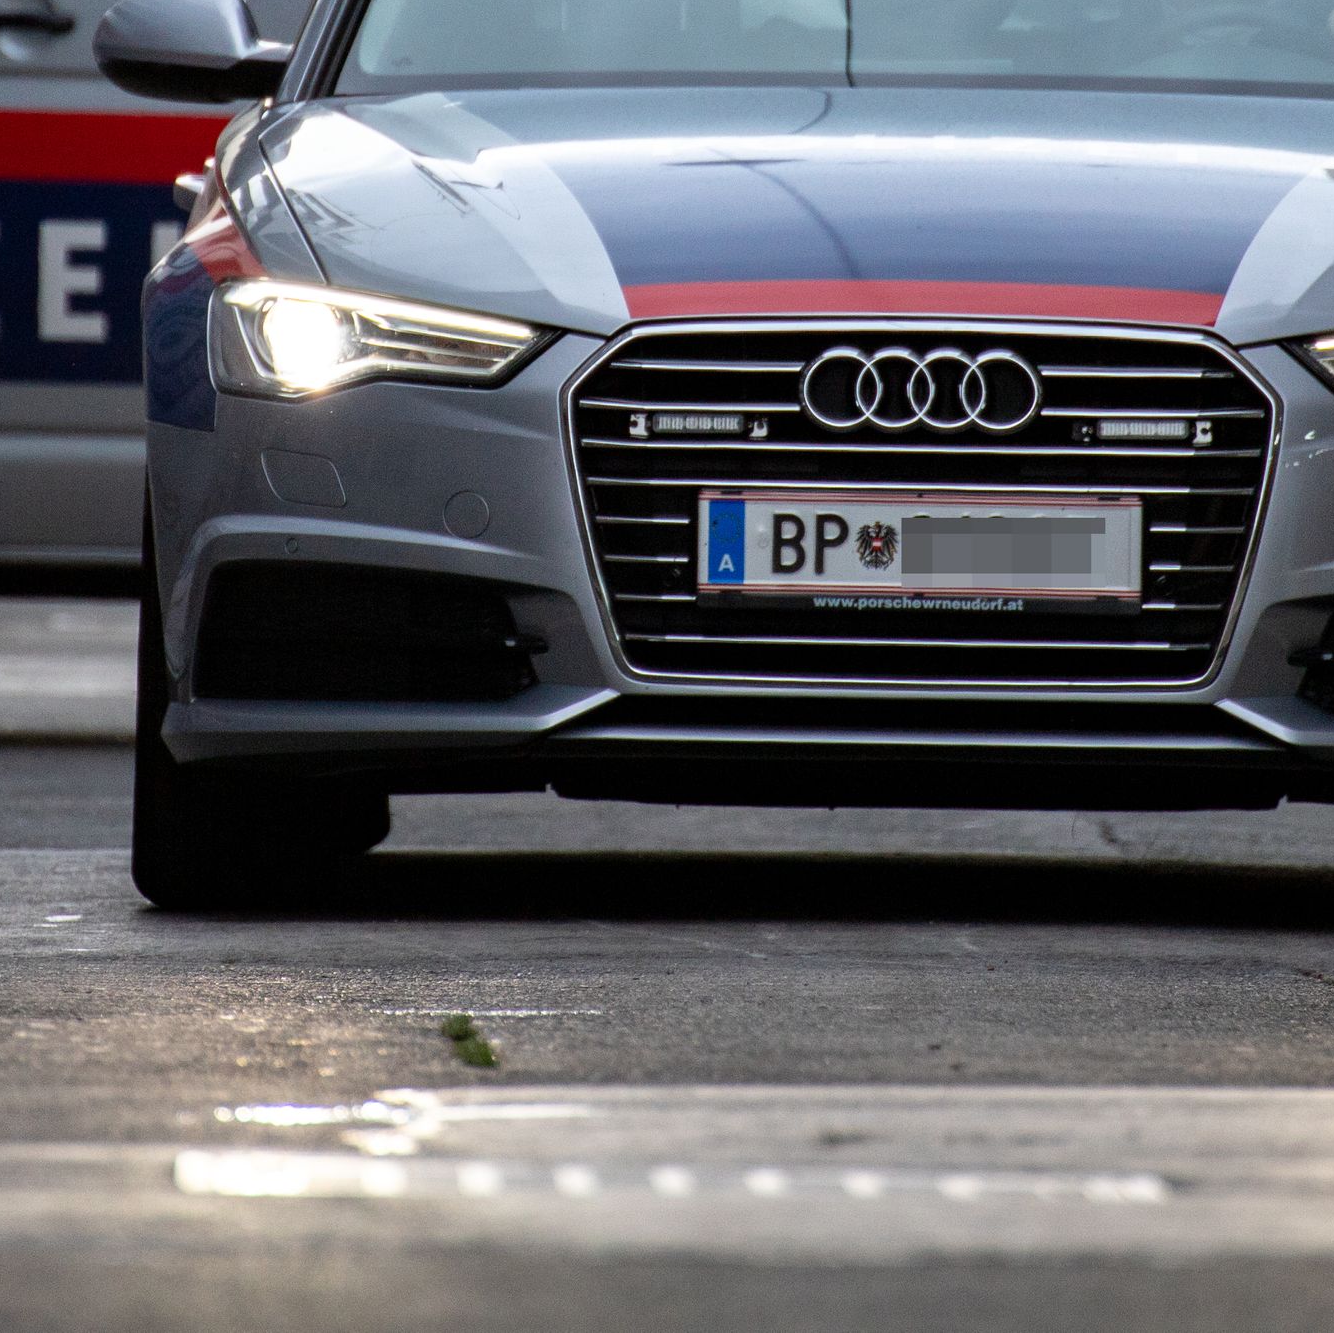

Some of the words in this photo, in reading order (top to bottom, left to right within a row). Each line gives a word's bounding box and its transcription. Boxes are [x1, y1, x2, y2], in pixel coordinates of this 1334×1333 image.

[771, 512, 850, 575] BP
[717, 553, 735, 573] A
[813, 594, 1024, 613] www.porschewrneudorf.at
